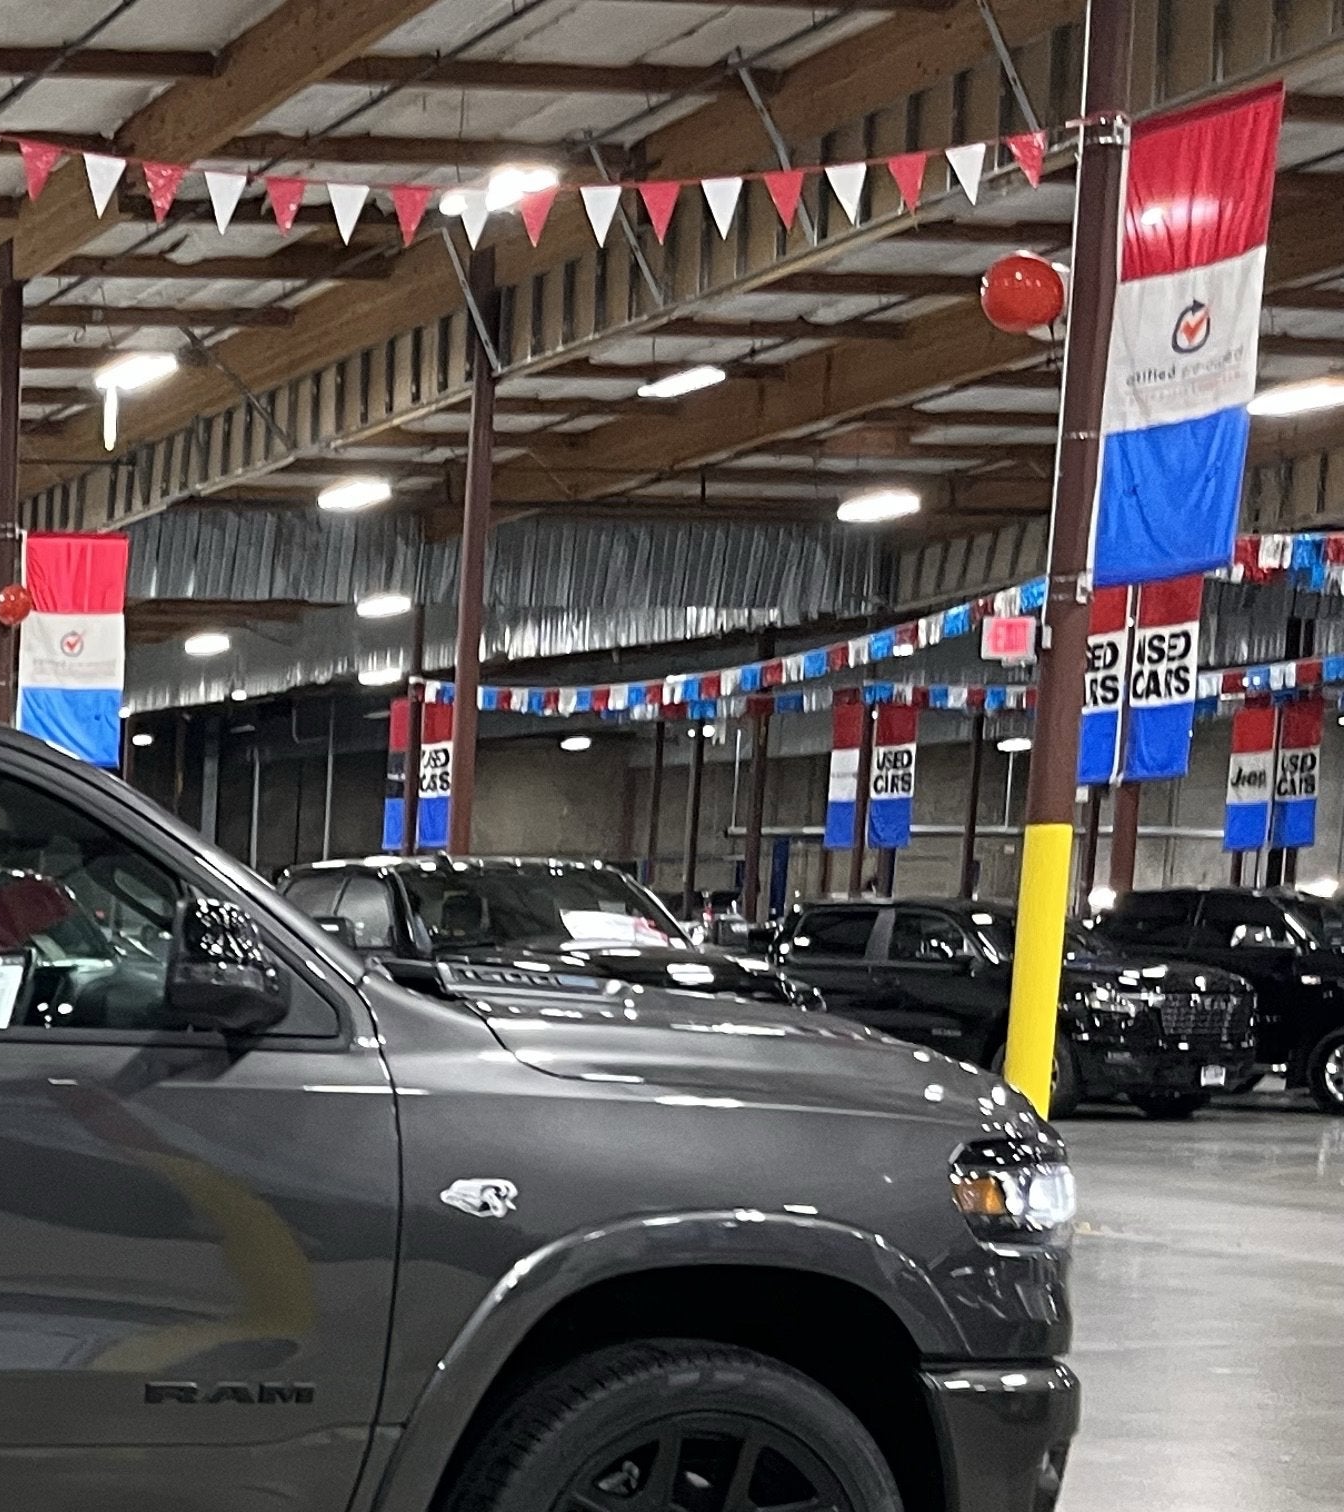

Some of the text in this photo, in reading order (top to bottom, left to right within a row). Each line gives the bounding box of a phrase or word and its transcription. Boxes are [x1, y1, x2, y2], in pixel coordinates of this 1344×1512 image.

[1126, 363, 1176, 387] tified
[1135, 629, 1192, 666] USED
[1132, 665, 1190, 700] CARS
[144, 1381, 315, 1403] RAM
